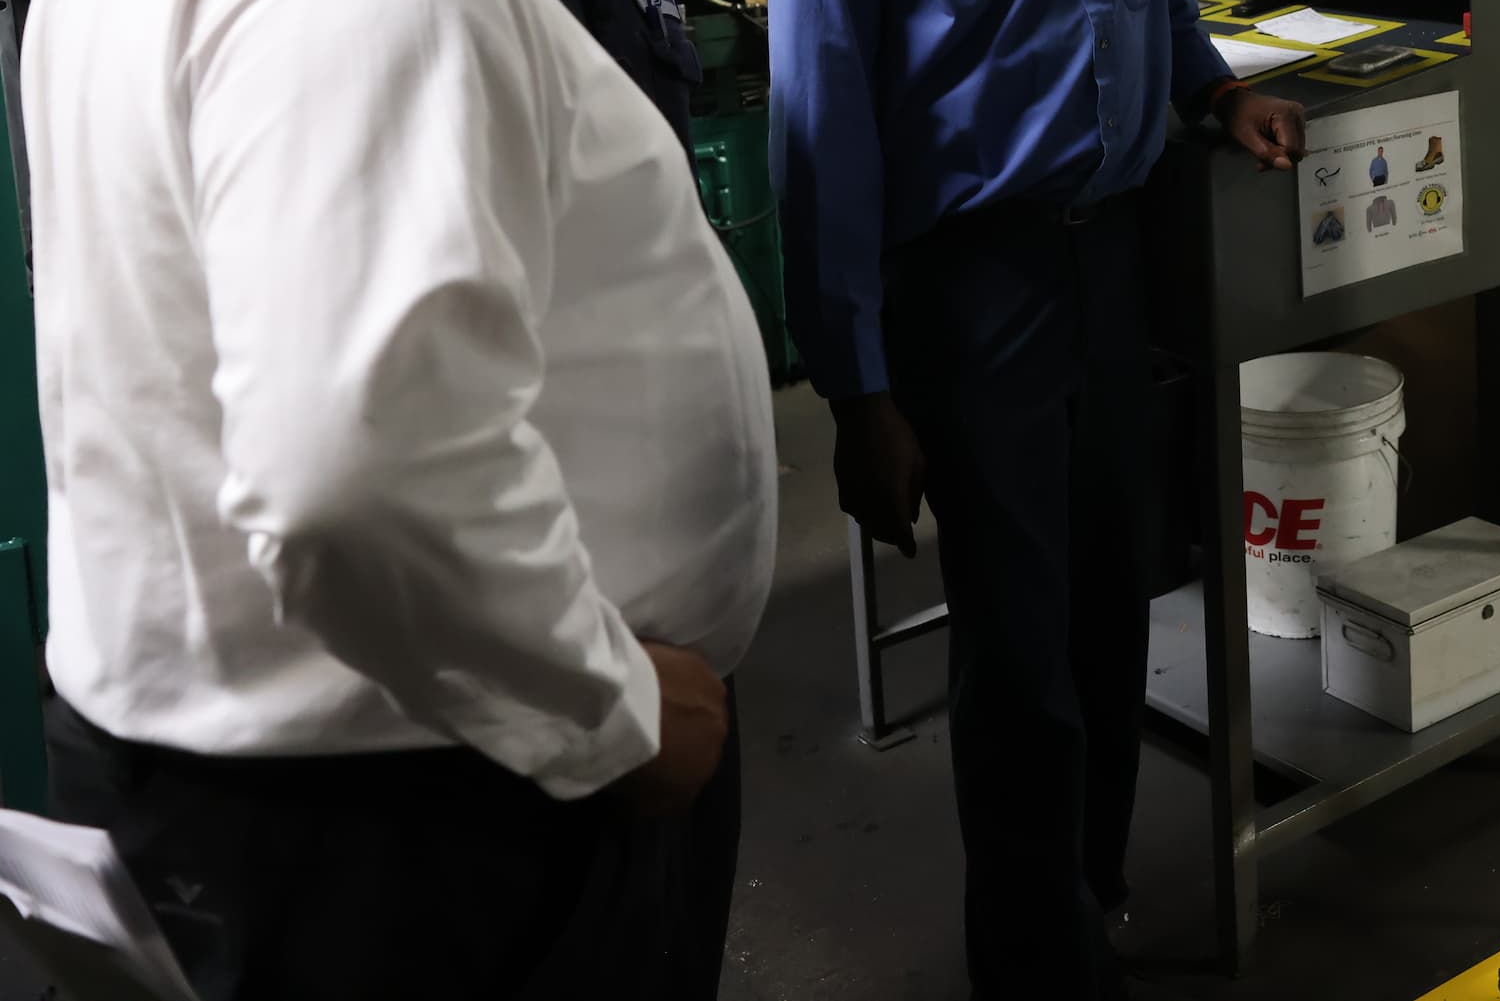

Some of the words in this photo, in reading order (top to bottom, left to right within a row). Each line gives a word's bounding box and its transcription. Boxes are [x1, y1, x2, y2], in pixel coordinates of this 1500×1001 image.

[1243, 490, 1325, 551] CE
[1245, 545, 1265, 559] ful
[1268, 551, 1316, 564] place.
